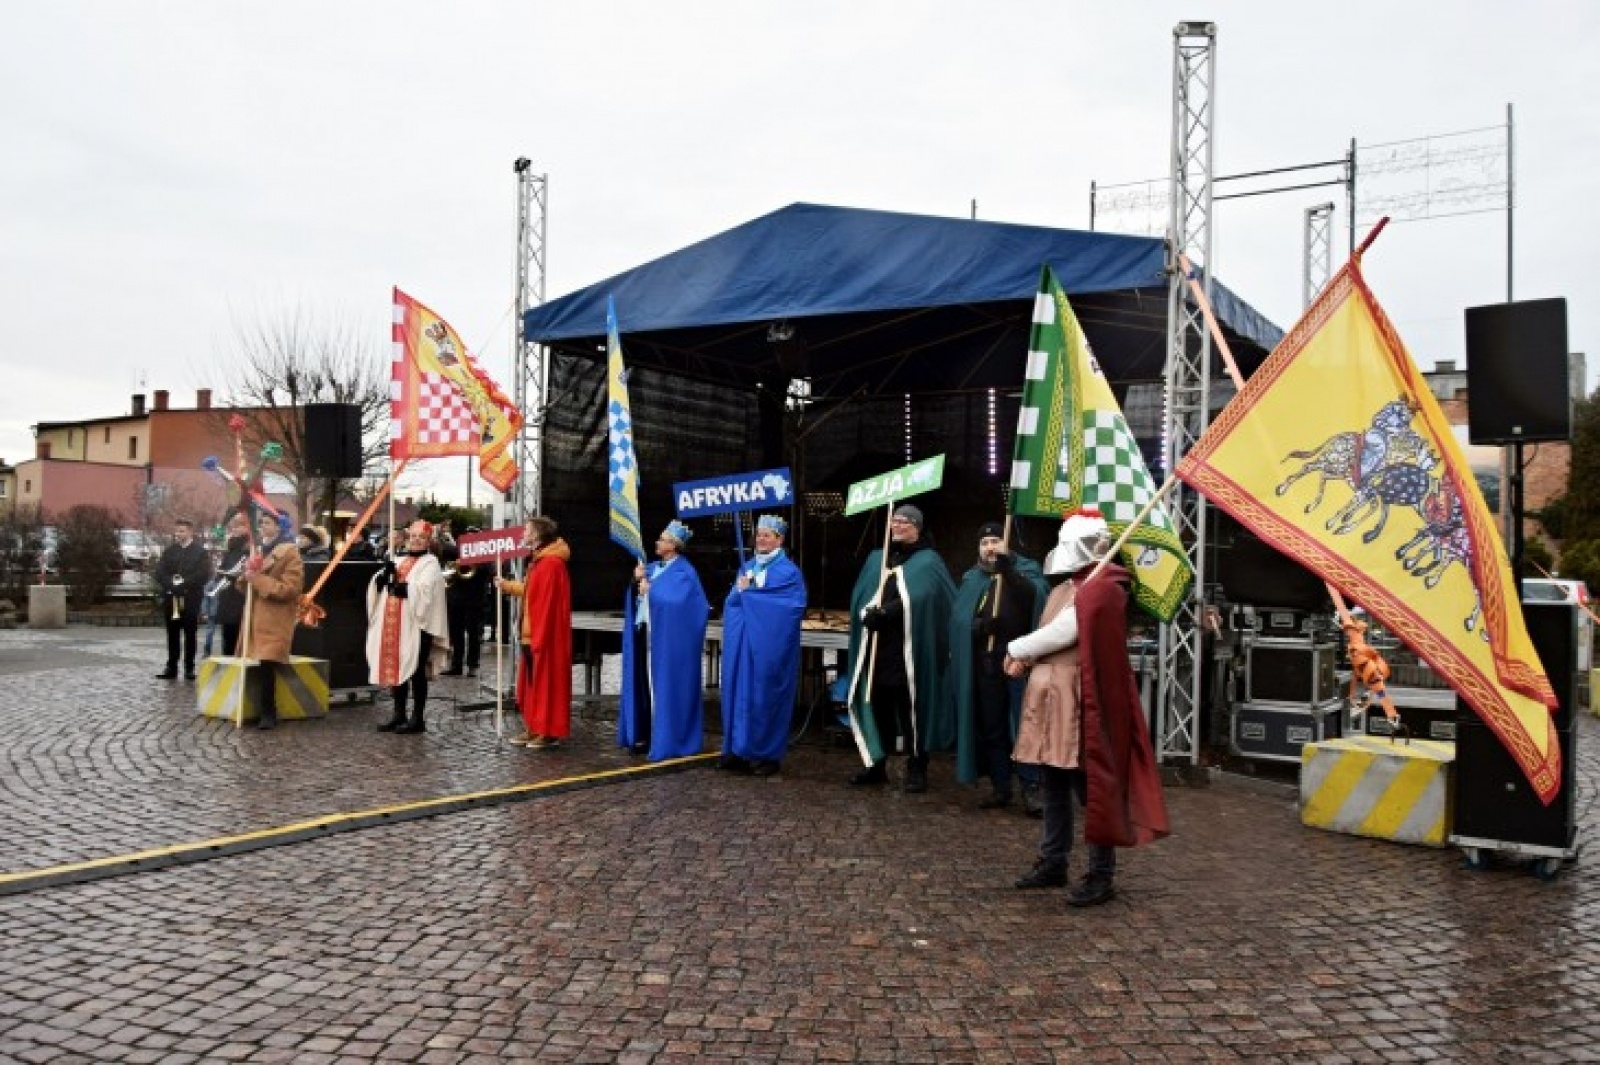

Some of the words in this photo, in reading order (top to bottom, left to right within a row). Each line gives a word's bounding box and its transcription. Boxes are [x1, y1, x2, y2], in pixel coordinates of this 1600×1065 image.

[679, 480, 766, 511] AFRYKA
[848, 473, 904, 506] AZJA
[461, 537, 515, 559] EUROPA
